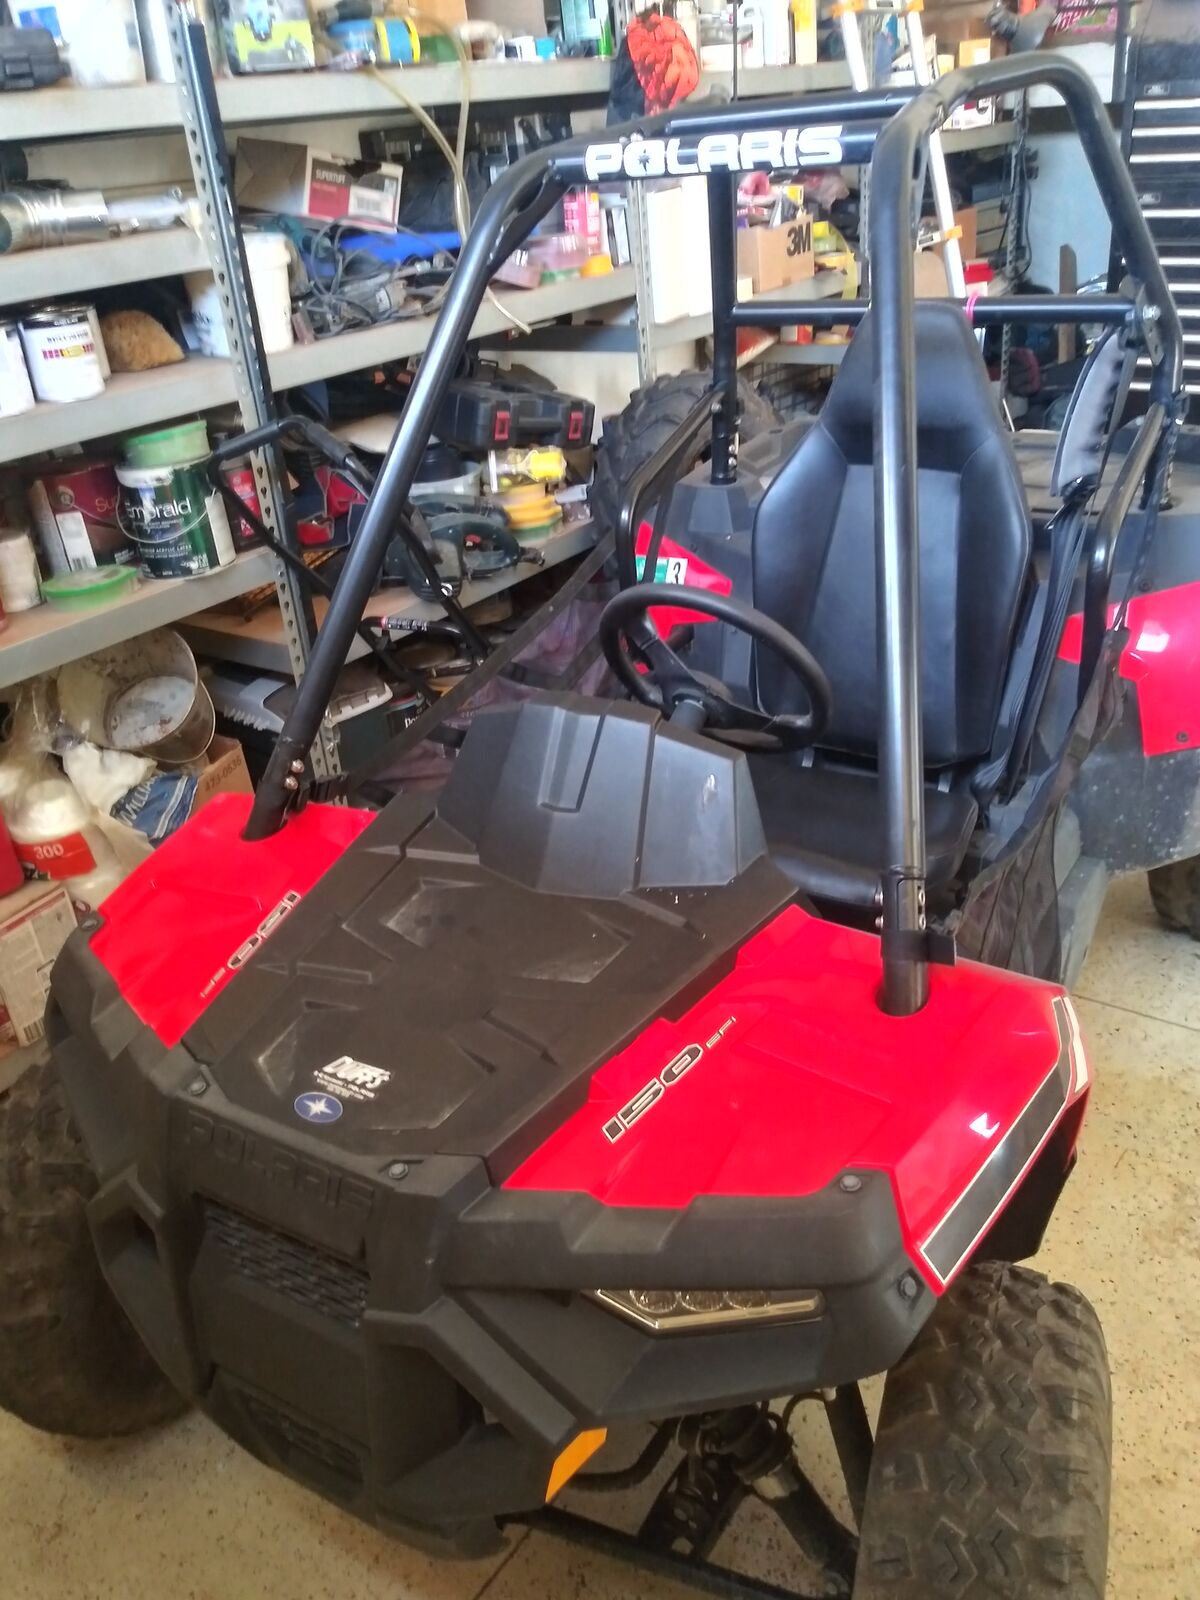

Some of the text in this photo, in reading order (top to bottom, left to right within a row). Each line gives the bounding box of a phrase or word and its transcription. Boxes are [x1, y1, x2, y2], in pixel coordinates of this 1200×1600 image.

[585, 125, 842, 181] POLARIS
[786, 221, 811, 257] 3M
[33, 843, 64, 860] 300
[602, 1016, 736, 1144] 150 EFI
[186, 1108, 376, 1216] POLARIS
